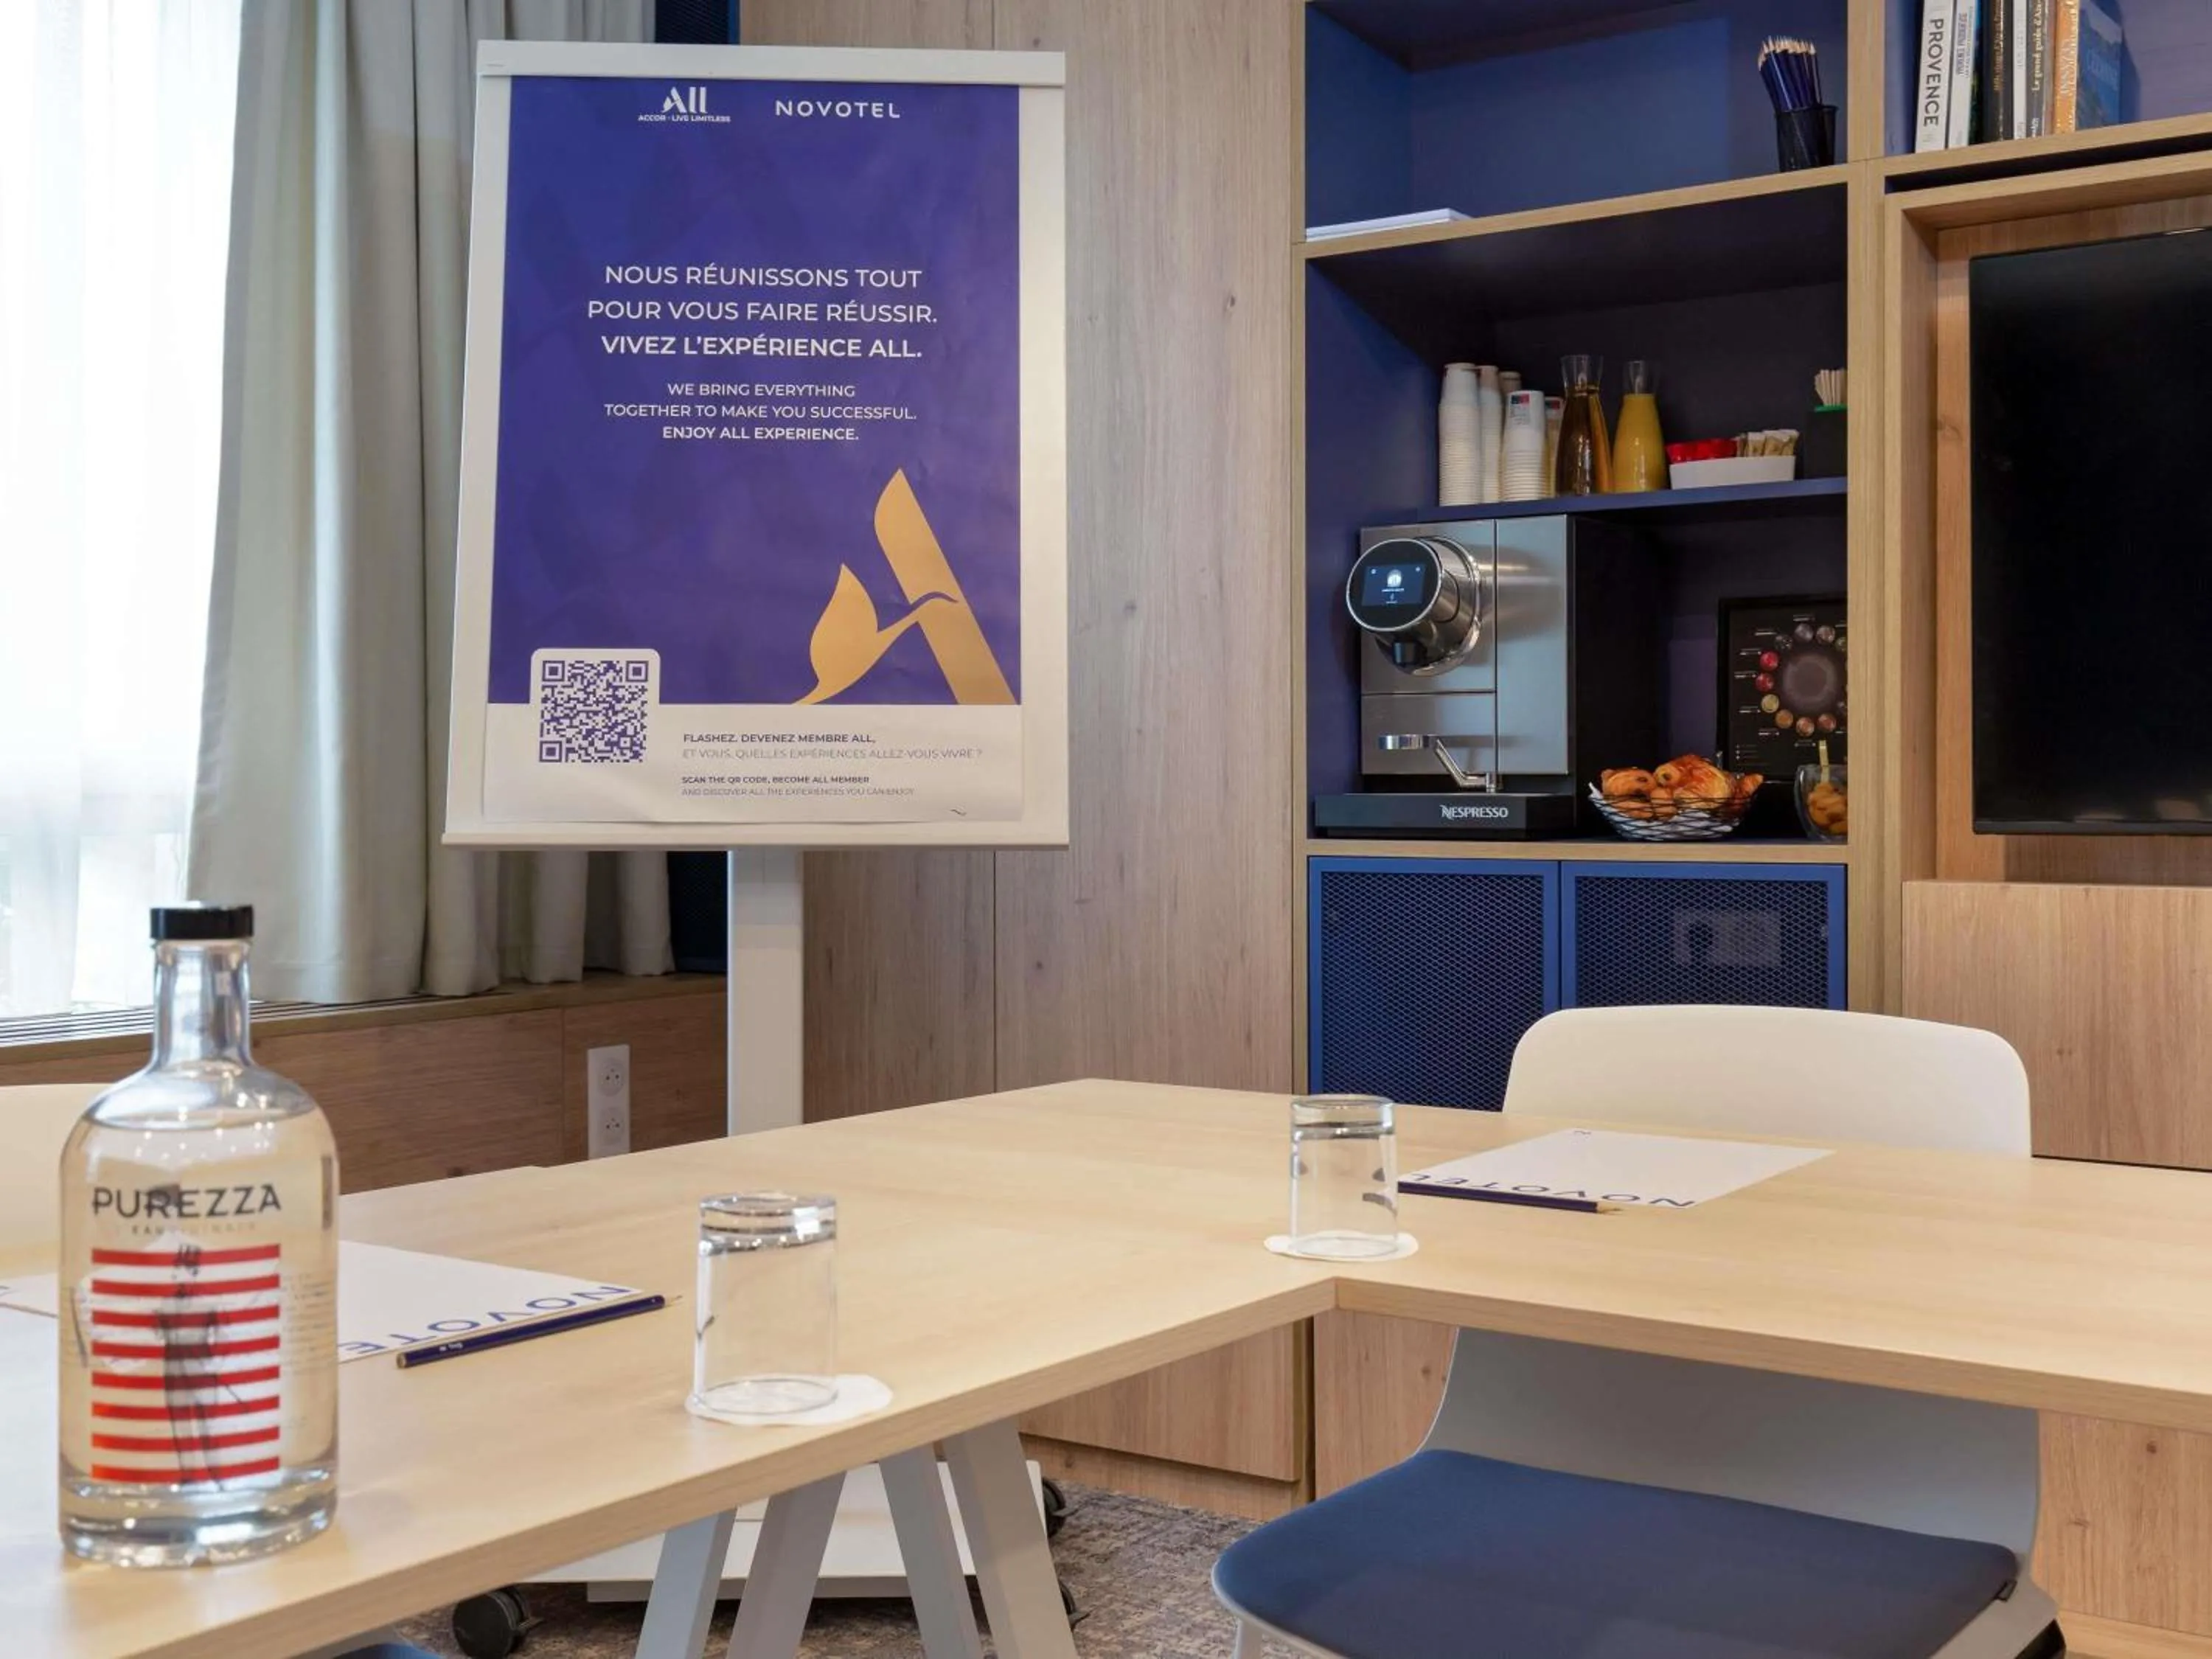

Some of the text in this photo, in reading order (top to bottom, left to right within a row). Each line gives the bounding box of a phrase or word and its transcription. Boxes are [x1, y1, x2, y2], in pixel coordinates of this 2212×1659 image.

[1923, 18, 1944, 127] PROVENCE
[776, 100, 900, 119] NOVOTEL
[691, 115, 731, 123] LIMITLESS
[605, 262, 922, 288] NOUS RÉUNISSONS TOUT
[588, 300, 937, 323] POUR VOUS FAIRE RÉUSSIR.
[601, 335, 676, 355] VIVEZ
[868, 338, 922, 358] ALL.
[667, 383, 855, 397] WE BRING EVERYTHING
[604, 403, 917, 420] TOGETHER TO MAKE YOU SUCCESSFUL.
[663, 426, 859, 441] ENJOY ALL EXPERIENCE.
[740, 734, 796, 742] DEVENEZ
[798, 734, 849, 742] MEMBRE
[683, 748, 696, 759] ET
[736, 748, 787, 760] QUELLES
[942, 748, 973, 759] VIVRE
[682, 787, 700, 796] AND
[703, 787, 748, 796] DISCOVER
[749, 787, 765, 796] ALL
[768, 787, 782, 796] THE
[847, 787, 864, 796] YOU
[1439, 804, 1509, 820] NESPRESSO
[1411, 1173, 1695, 1208] NOVOTEL
[92, 1183, 281, 1217] PUREZZA
[338, 1286, 632, 1355] NOVOTE
